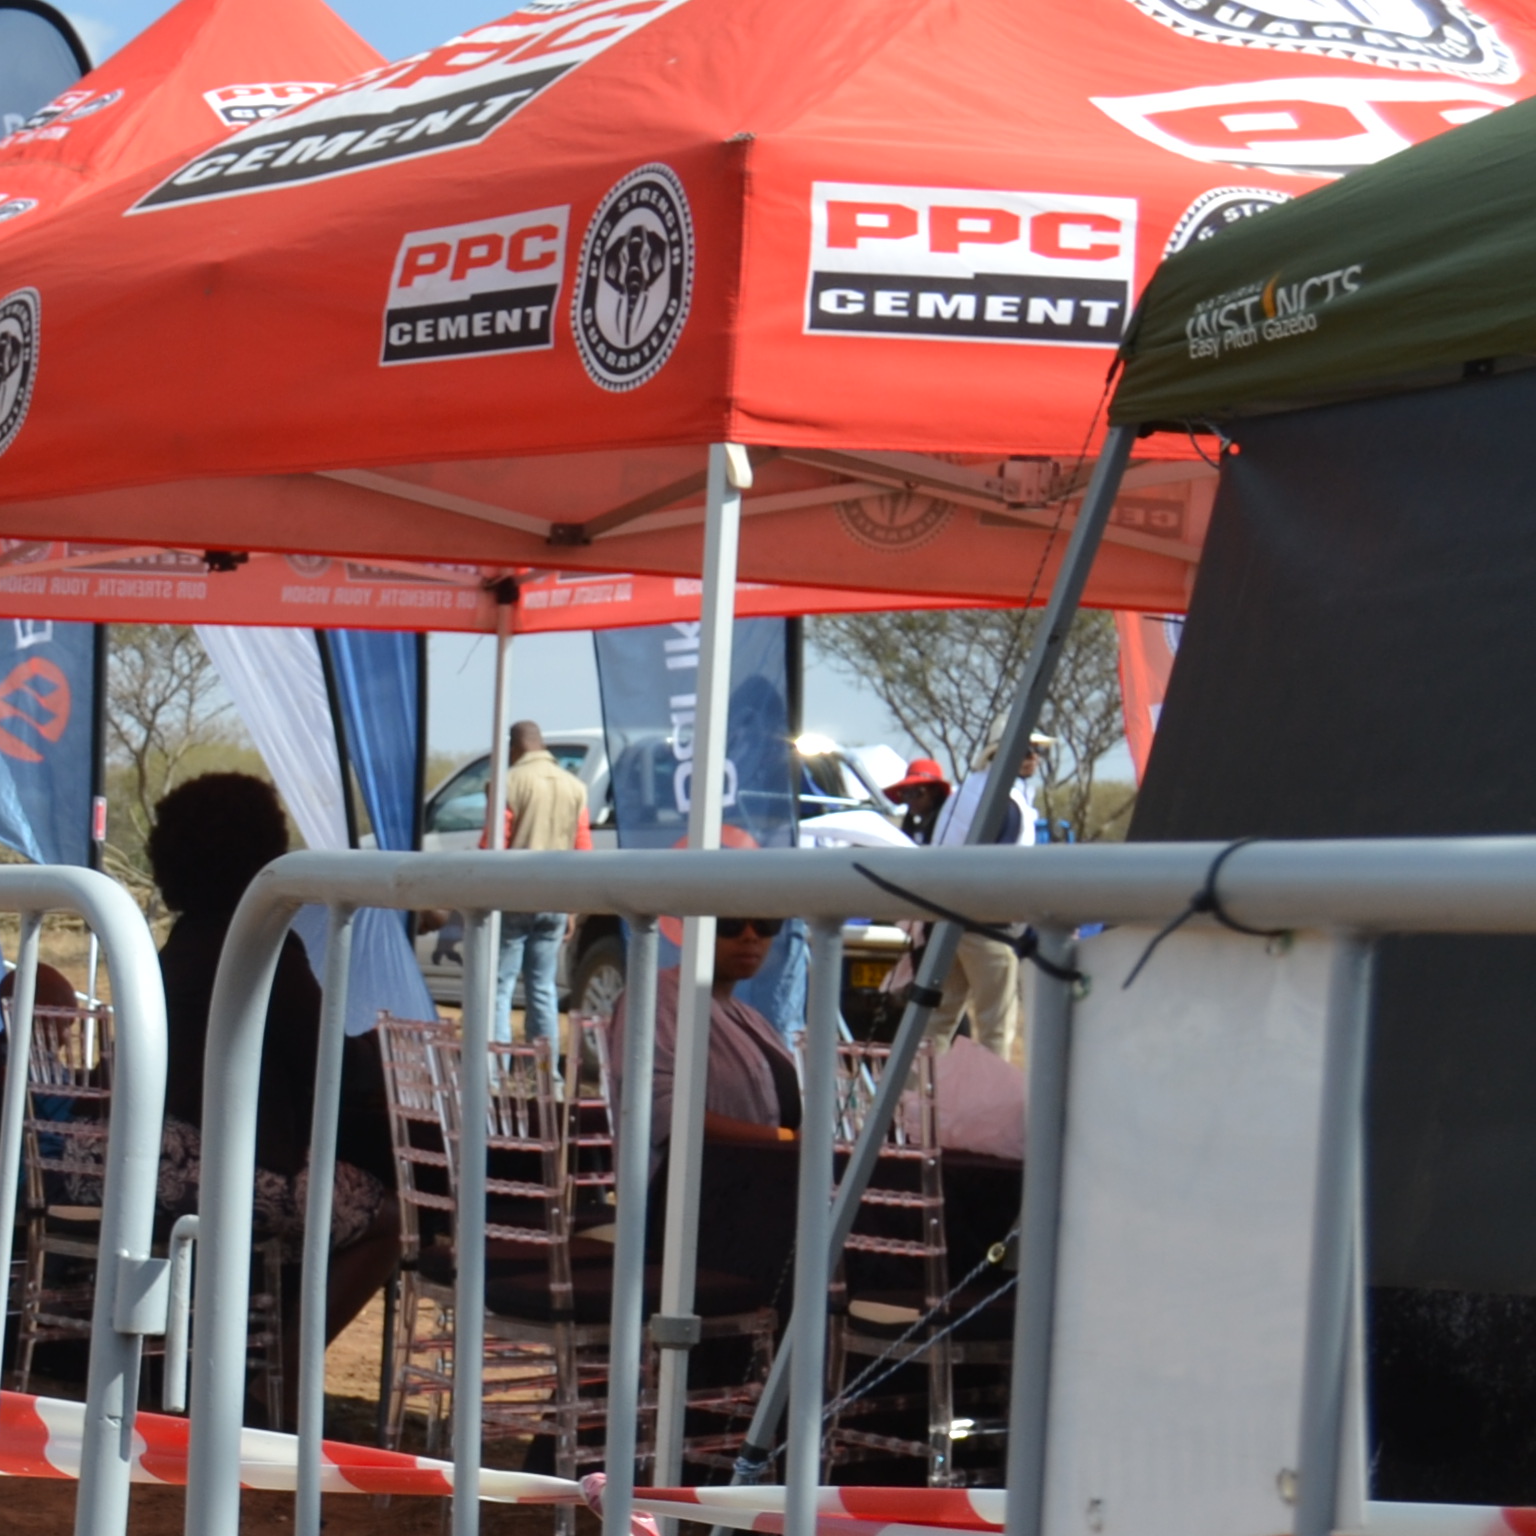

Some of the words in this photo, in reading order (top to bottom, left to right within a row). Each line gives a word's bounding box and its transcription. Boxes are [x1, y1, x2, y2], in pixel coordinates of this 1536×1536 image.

[216, 86, 324, 102] PP
[172, 88, 534, 186] CEMENT
[397, 223, 560, 289] PPC
[618, 187, 681, 266] STRENGTH
[825, 199, 1123, 262] PPC
[388, 305, 548, 346] CEMENT
[583, 298, 680, 370] GUARANTEED
[818, 288, 1120, 327] CEMENT
[1189, 335, 1221, 360] Easy
[1261, 313, 1318, 341] Gazebo
